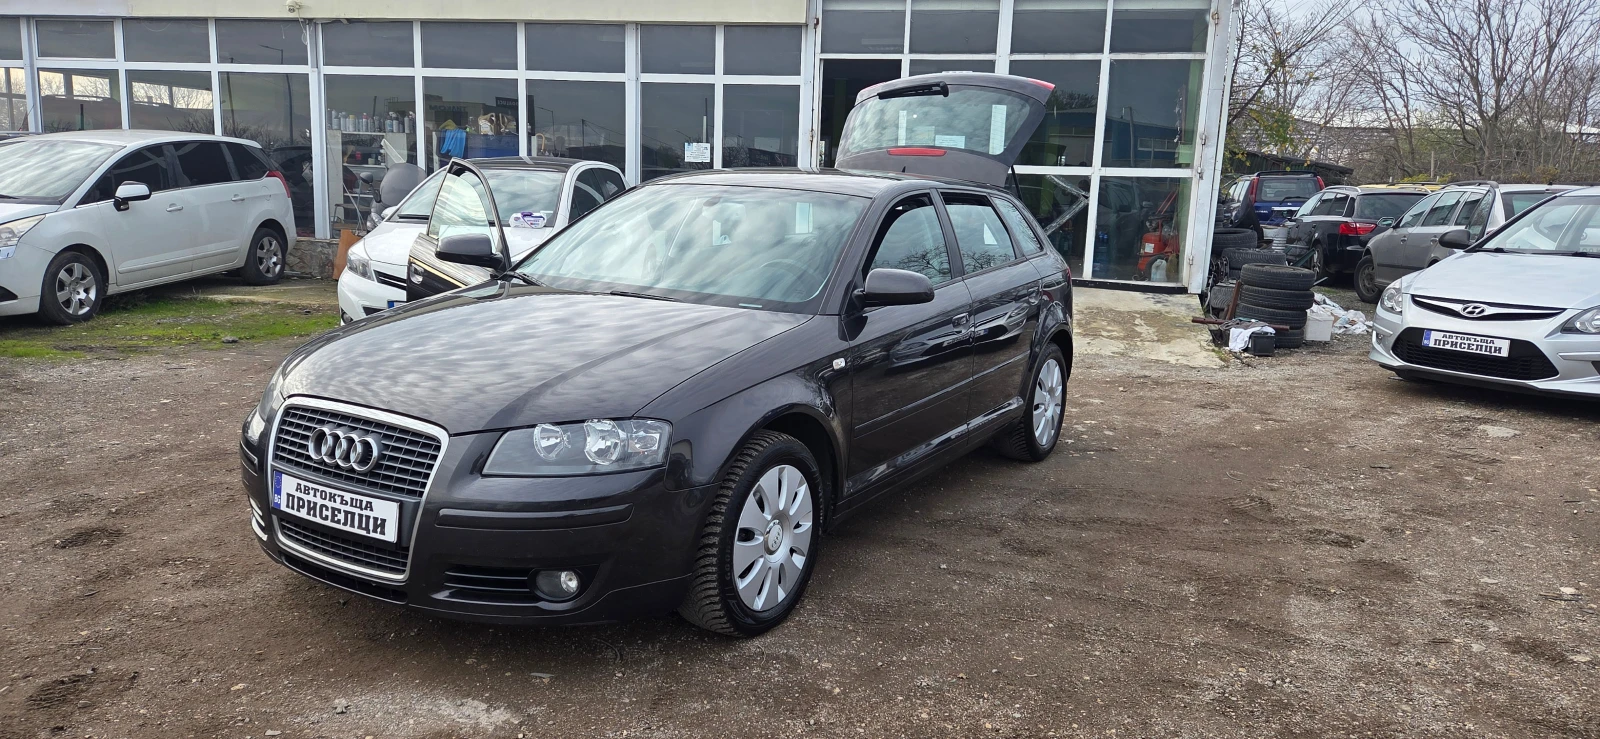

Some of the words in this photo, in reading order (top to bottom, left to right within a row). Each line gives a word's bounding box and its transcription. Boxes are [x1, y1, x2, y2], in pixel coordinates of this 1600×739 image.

[1433, 338, 1502, 354] ПРИСЕЛЦИ
[1442, 334, 1495, 345] АВТОКЪЩА
[274, 493, 281, 504] BG
[295, 483, 374, 512] АВТОКЪЩА
[285, 492, 387, 536] ПРИСЕЛЦИ
